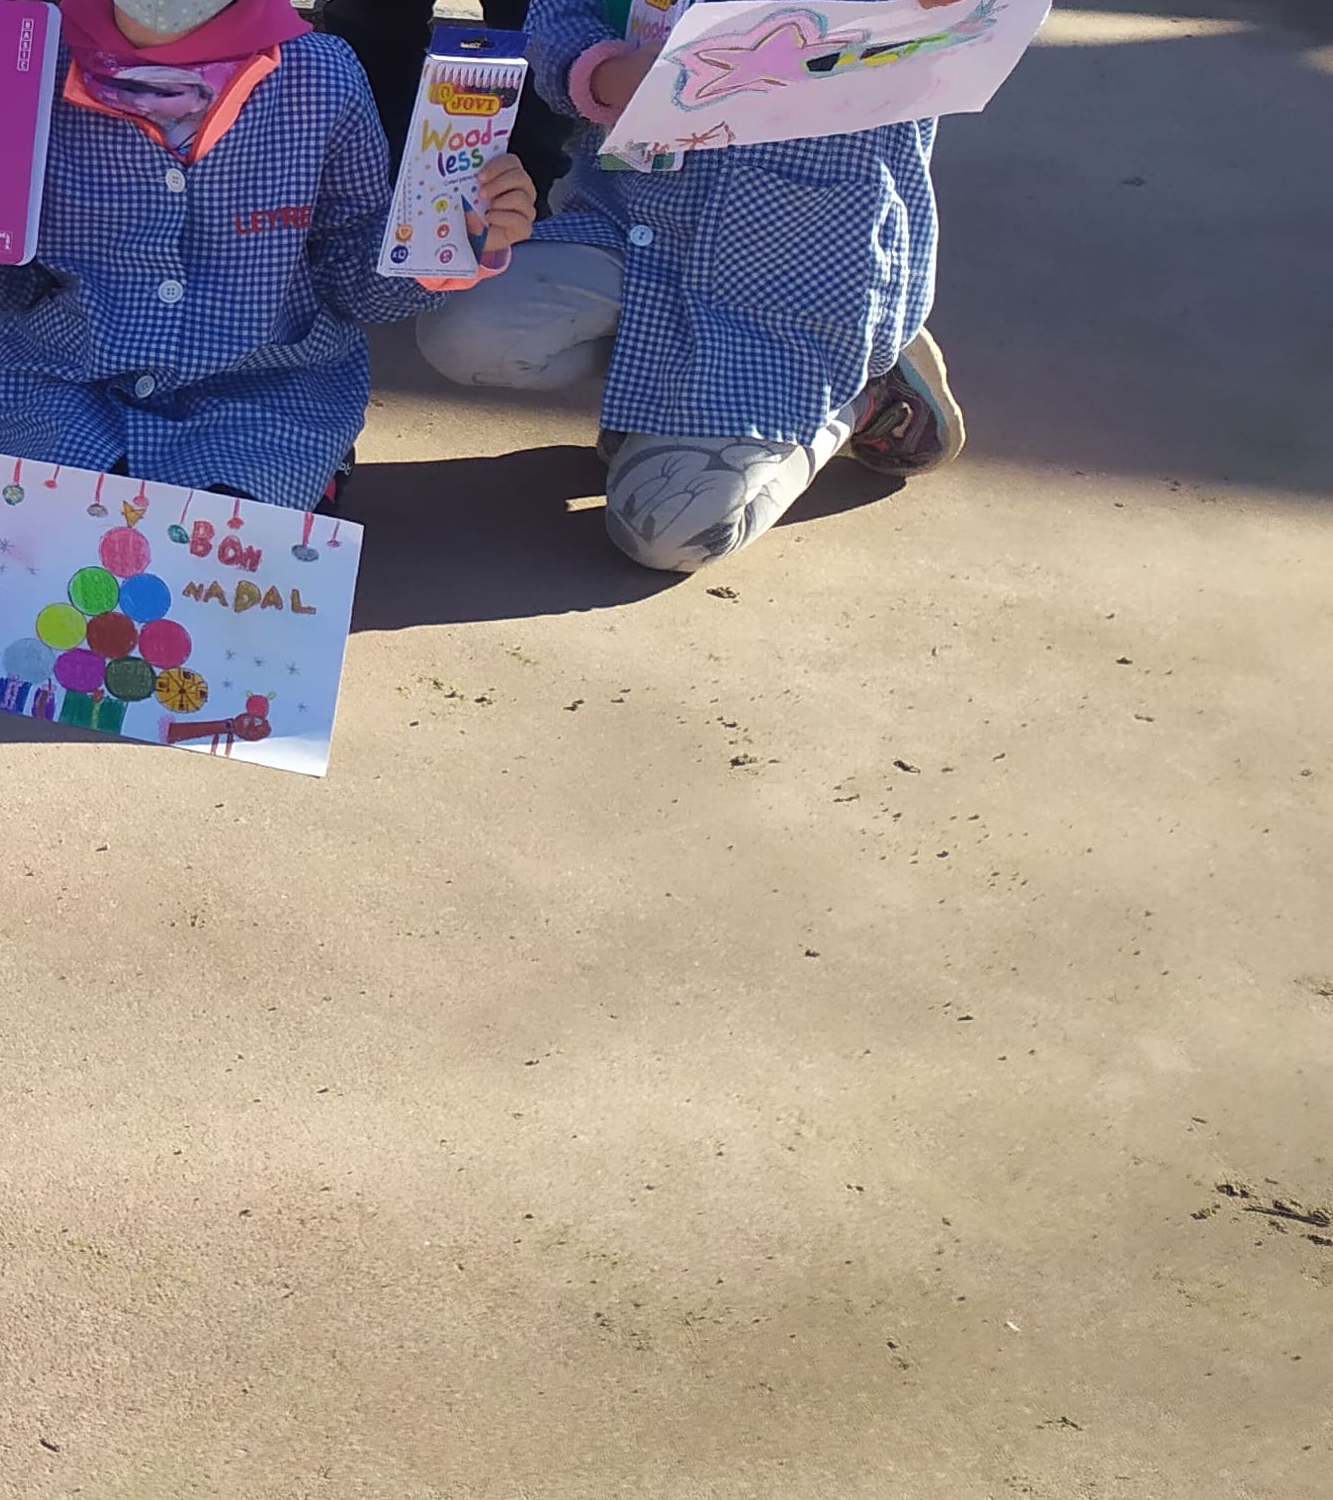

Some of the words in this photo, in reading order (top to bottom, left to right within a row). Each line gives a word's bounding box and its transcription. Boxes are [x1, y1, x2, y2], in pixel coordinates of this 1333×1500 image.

[450, 97, 496, 112] JOVI
[421, 118, 509, 153] Wood-
[437, 148, 485, 178] less
[235, 204, 313, 235] LEYRE
[190, 520, 263, 573] BON
[182, 580, 317, 615] NADAL
